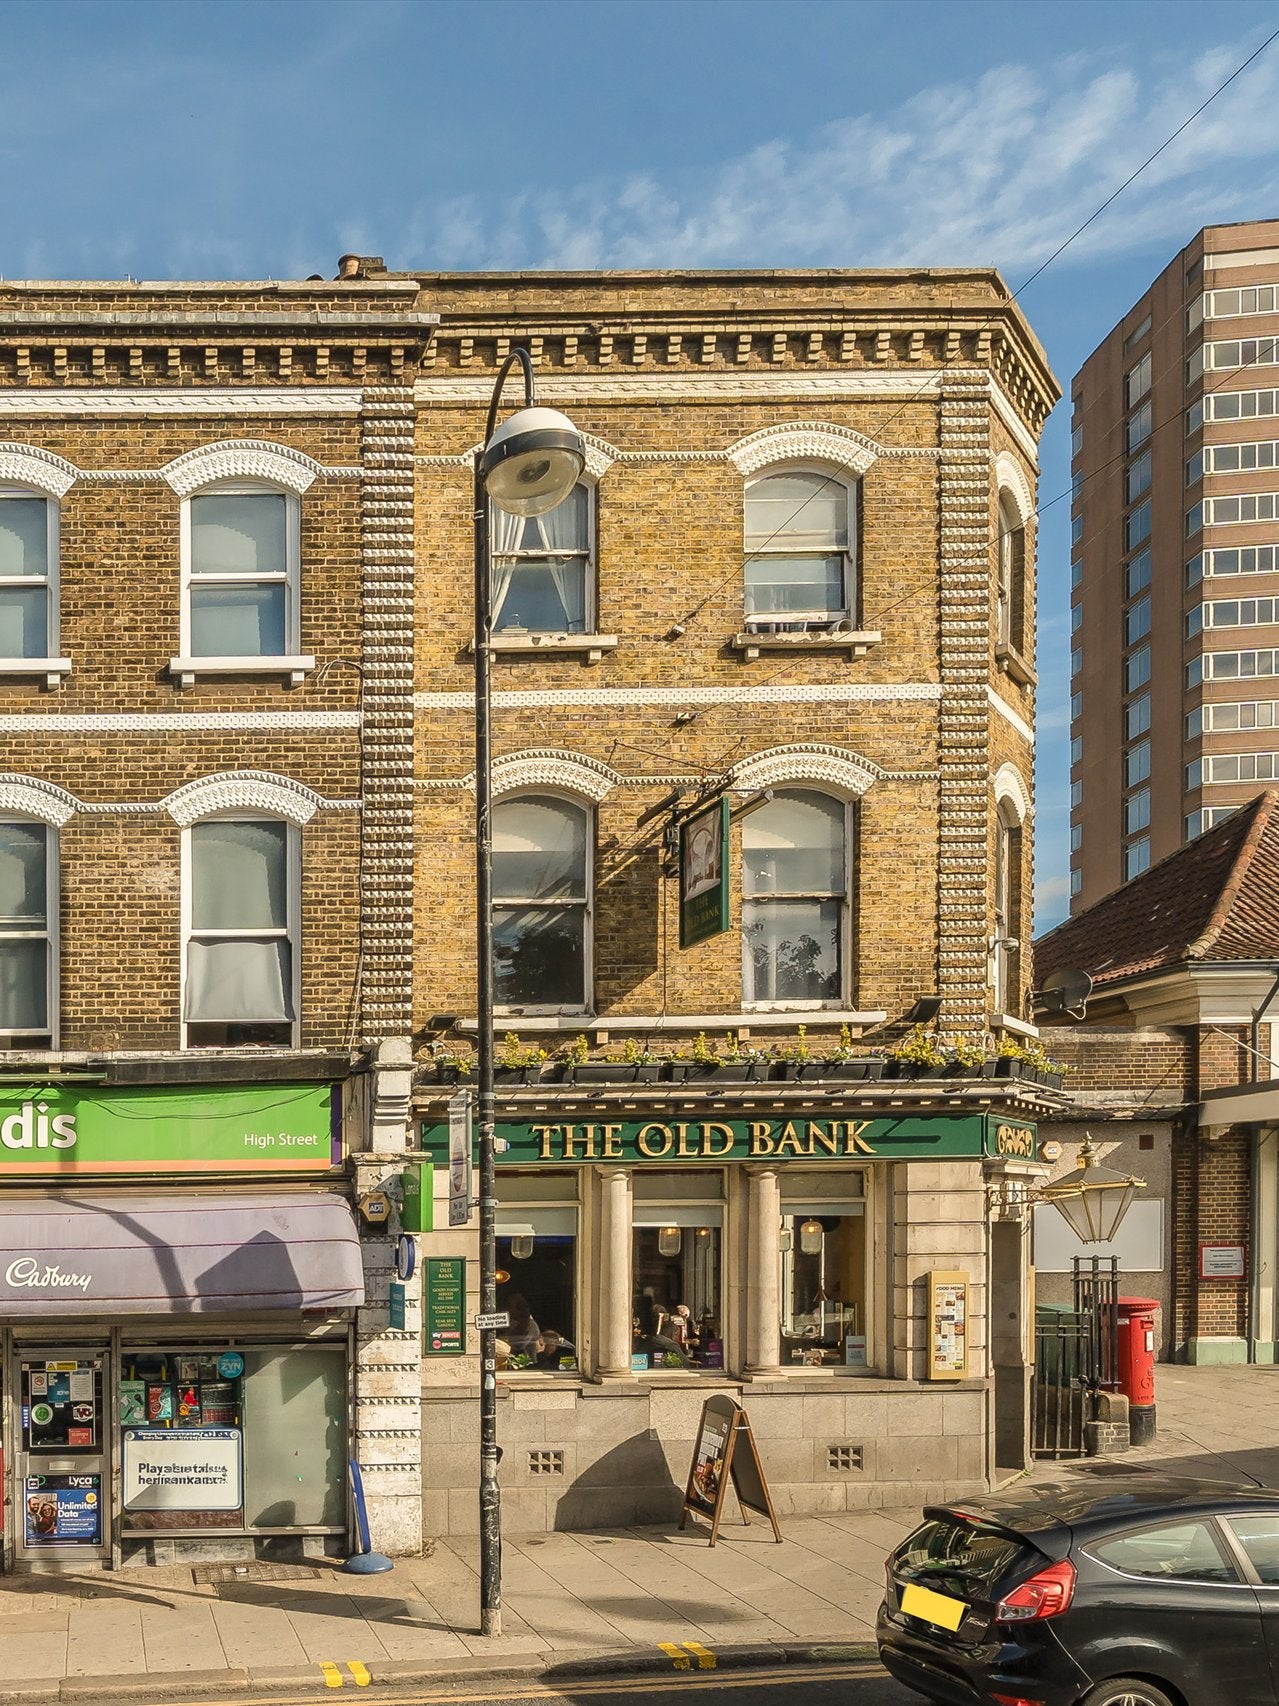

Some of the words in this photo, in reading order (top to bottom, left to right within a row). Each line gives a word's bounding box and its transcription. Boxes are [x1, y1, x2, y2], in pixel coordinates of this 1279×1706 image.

[244, 1133, 275, 1149] High
[278, 1133, 318, 1146] Street
[532, 1123, 624, 1158] THE
[638, 1122, 735, 1157] OLD
[749, 1120, 877, 1156] BANK
[5, 1257, 92, 1292] Cadbury
[221, 1362, 241, 1370] ZYN
[487, 1360, 494, 1368] 3
[68, 1475, 93, 1487] Lyca
[57, 1501, 97, 1510] Unlimited
[57, 1509, 79, 1518] Data
